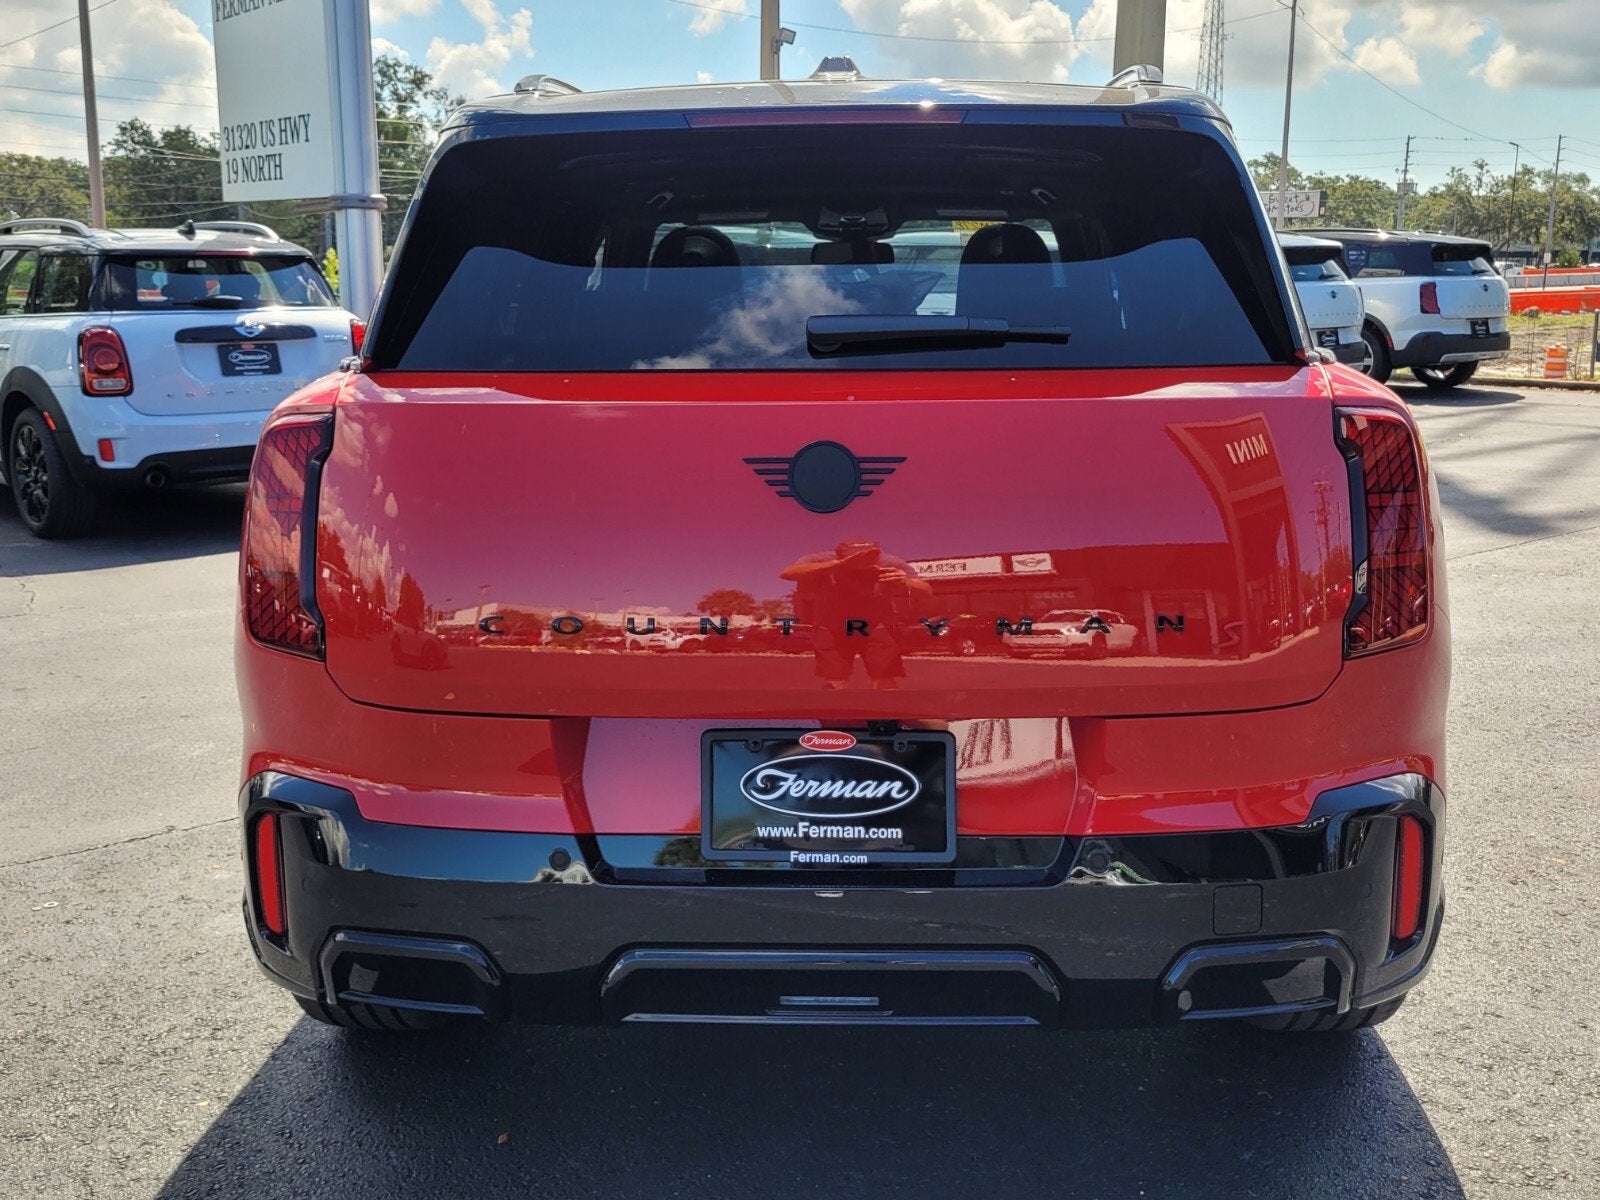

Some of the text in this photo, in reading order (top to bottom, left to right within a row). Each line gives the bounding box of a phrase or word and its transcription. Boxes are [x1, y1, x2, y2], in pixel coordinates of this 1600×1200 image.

[215, 0, 265, 22] FERM
[223, 113, 311, 152] 31320 US HWY
[226, 153, 283, 184] 19 NORTH
[479, 614, 1185, 637] COUNTRYMAN
[803, 735, 852, 745] Ferman
[751, 768, 910, 800] Ferman
[757, 822, 902, 839] www.Ferman.com
[790, 851, 868, 864] Ferman.com
